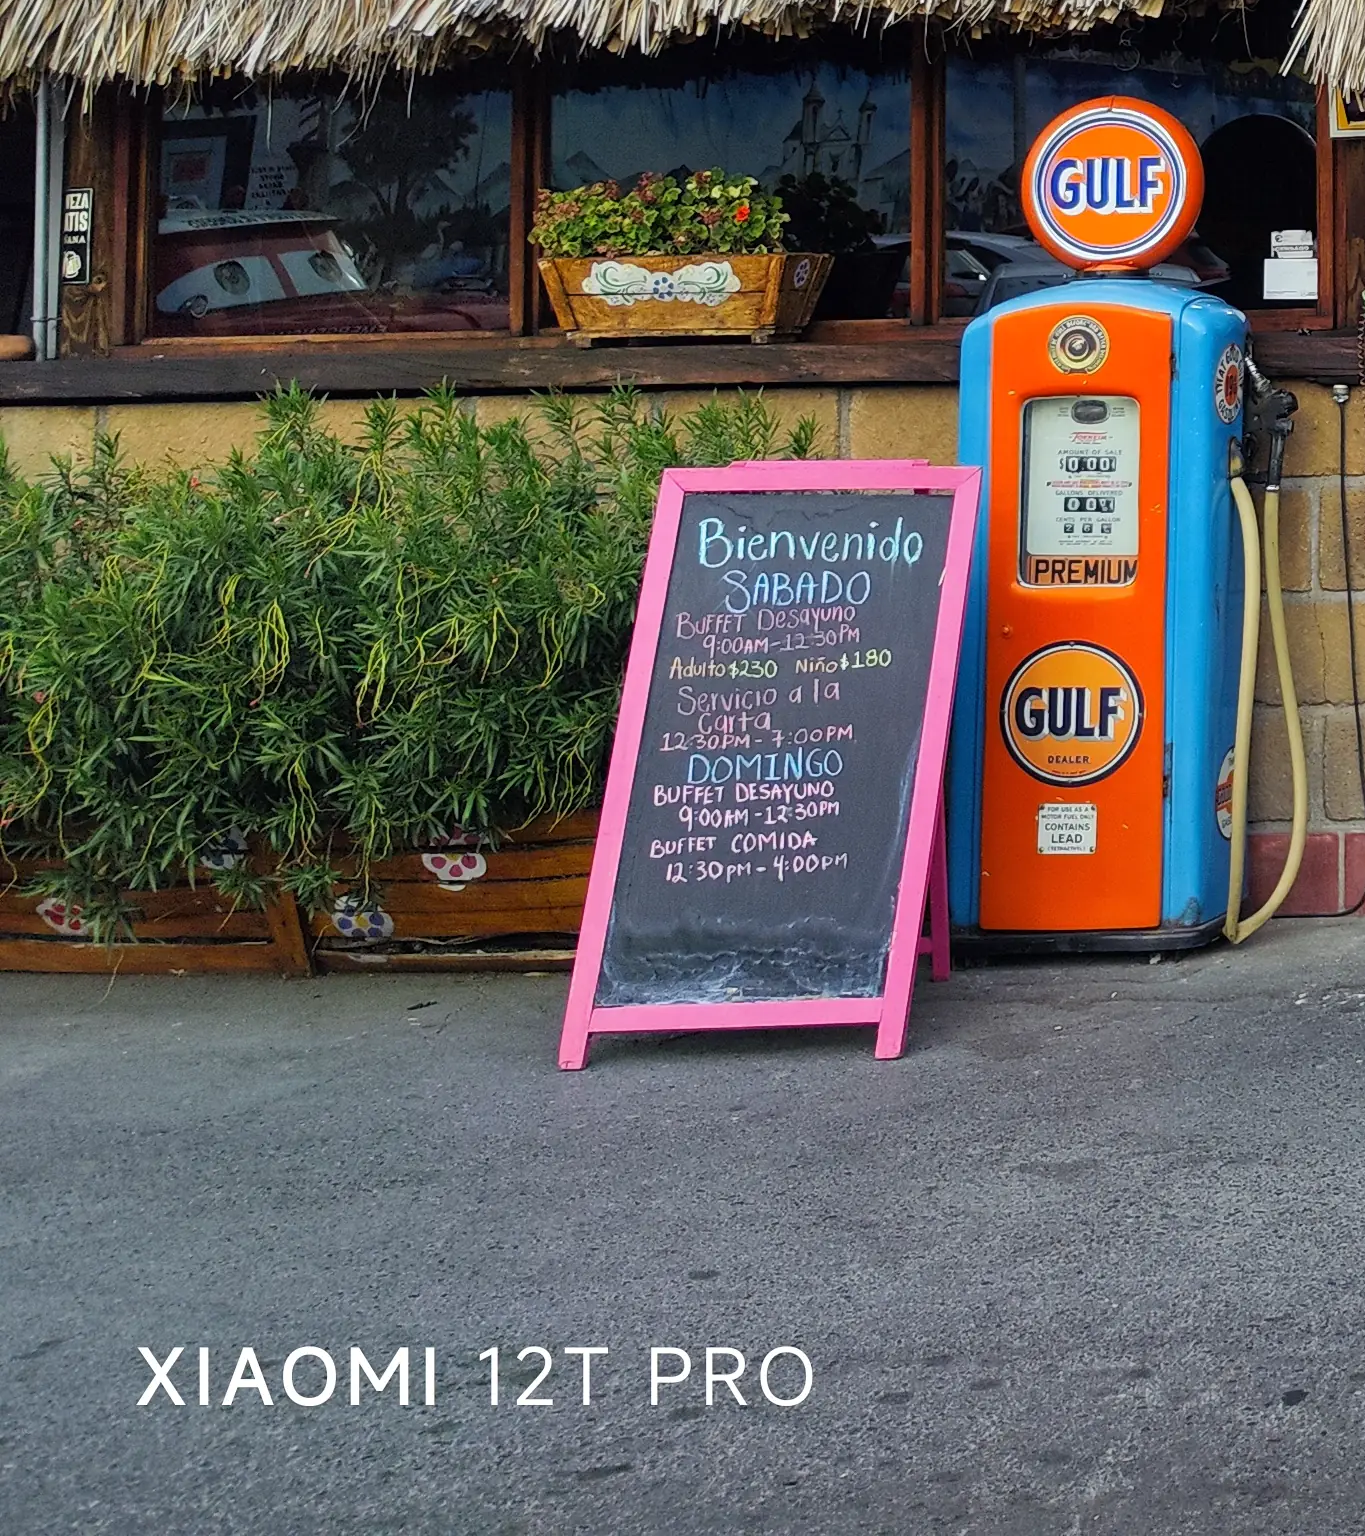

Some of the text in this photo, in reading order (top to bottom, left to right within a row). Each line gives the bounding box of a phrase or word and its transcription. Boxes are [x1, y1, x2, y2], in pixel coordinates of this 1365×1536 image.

[1051, 157, 1165, 215] GULF
[699, 517, 923, 568] Bienvenido
[1034, 559, 1138, 584] PREMIUM
[722, 570, 871, 613] SABADO
[758, 606, 856, 634] Desayuno
[677, 679, 840, 716] Servicio a la
[698, 711, 771, 735] Carta
[1015, 686, 1127, 742] GULF
[687, 747, 844, 784] DOMINGO
[1048, 755, 1090, 764] DEALER
[653, 780, 835, 806] BUFFET DESAYUNO
[1045, 823, 1090, 831] CONTAINS
[1051, 833, 1083, 844] LEAD
[649, 830, 818, 859] BUFFET COMIDA
